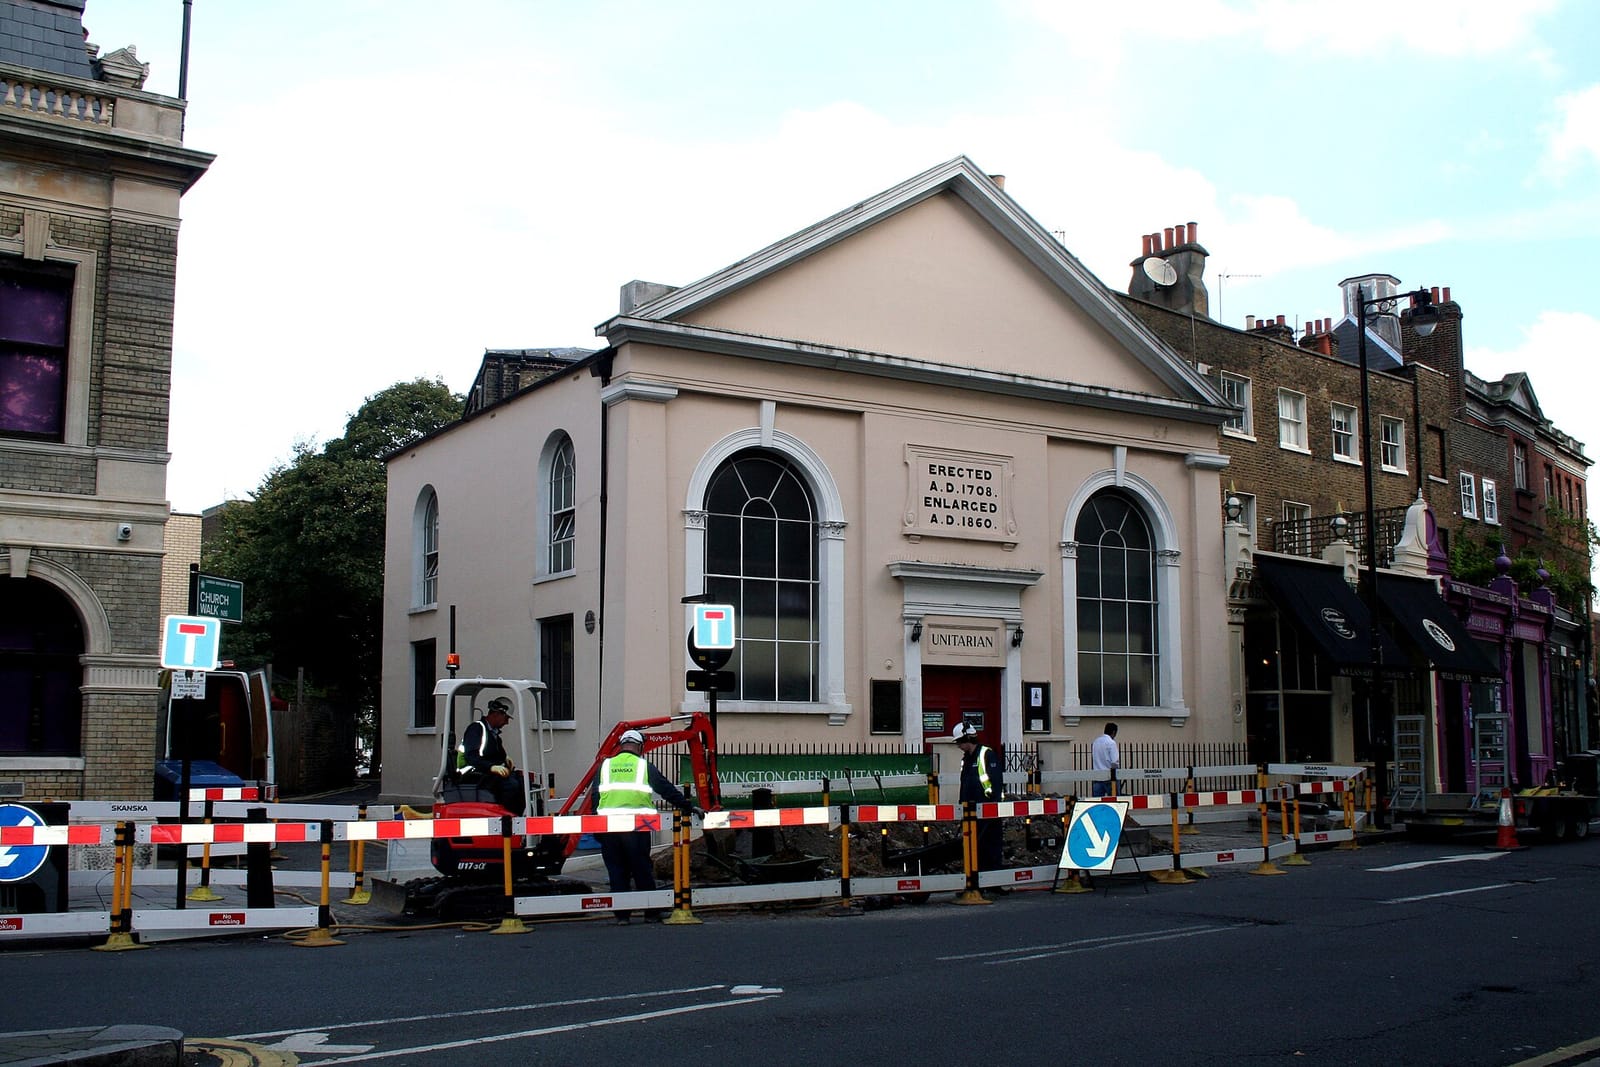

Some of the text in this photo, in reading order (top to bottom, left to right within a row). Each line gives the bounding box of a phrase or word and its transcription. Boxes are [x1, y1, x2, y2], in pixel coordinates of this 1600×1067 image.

[928, 463, 993, 481] ERECTED
[929, 481, 998, 498] A.D.1708.
[923, 497, 998, 514] ENLARGED
[930, 513, 998, 530] A.D.1860.
[200, 591, 230, 606] CHURCH
[199, 602, 219, 616] WALK
[931, 633, 994, 648] UNITARIAN
[787, 768, 832, 781] GREEN
[111, 804, 148, 812] SKANSKA
